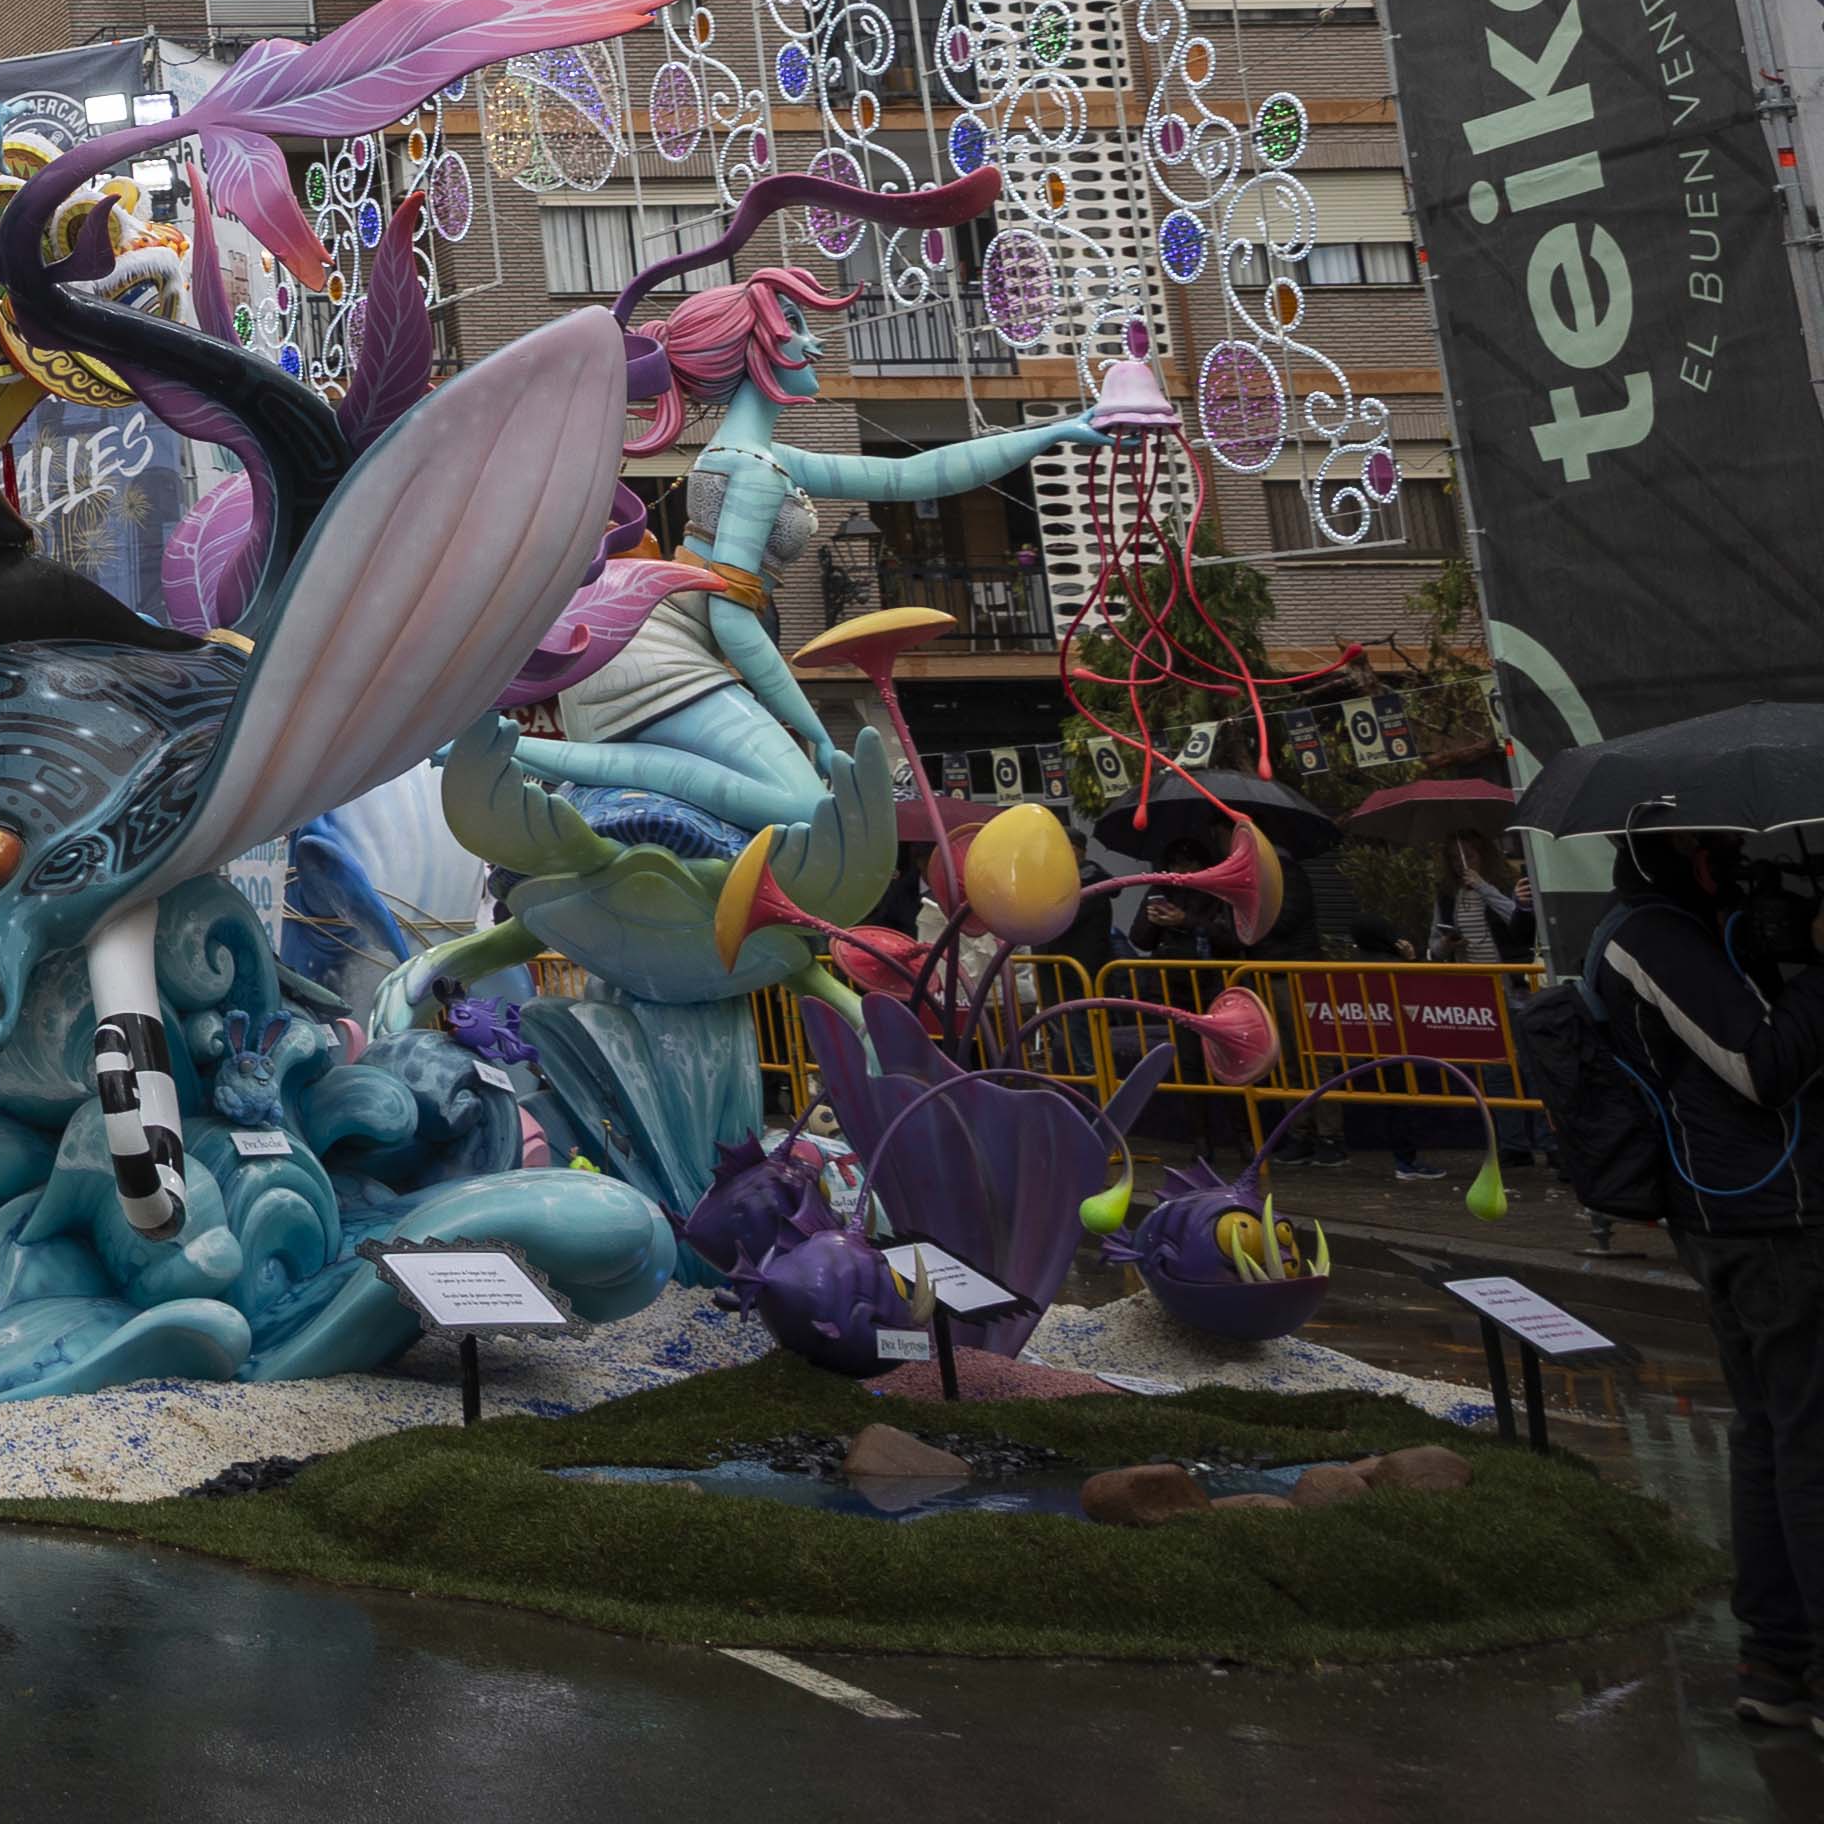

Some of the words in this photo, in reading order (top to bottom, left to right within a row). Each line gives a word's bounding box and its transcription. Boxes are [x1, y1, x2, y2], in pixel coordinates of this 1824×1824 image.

[1678, 148, 1724, 304] BUEN
[1680, 332, 1718, 393] EL
[1421, 1006, 1498, 1026] AMBAR
